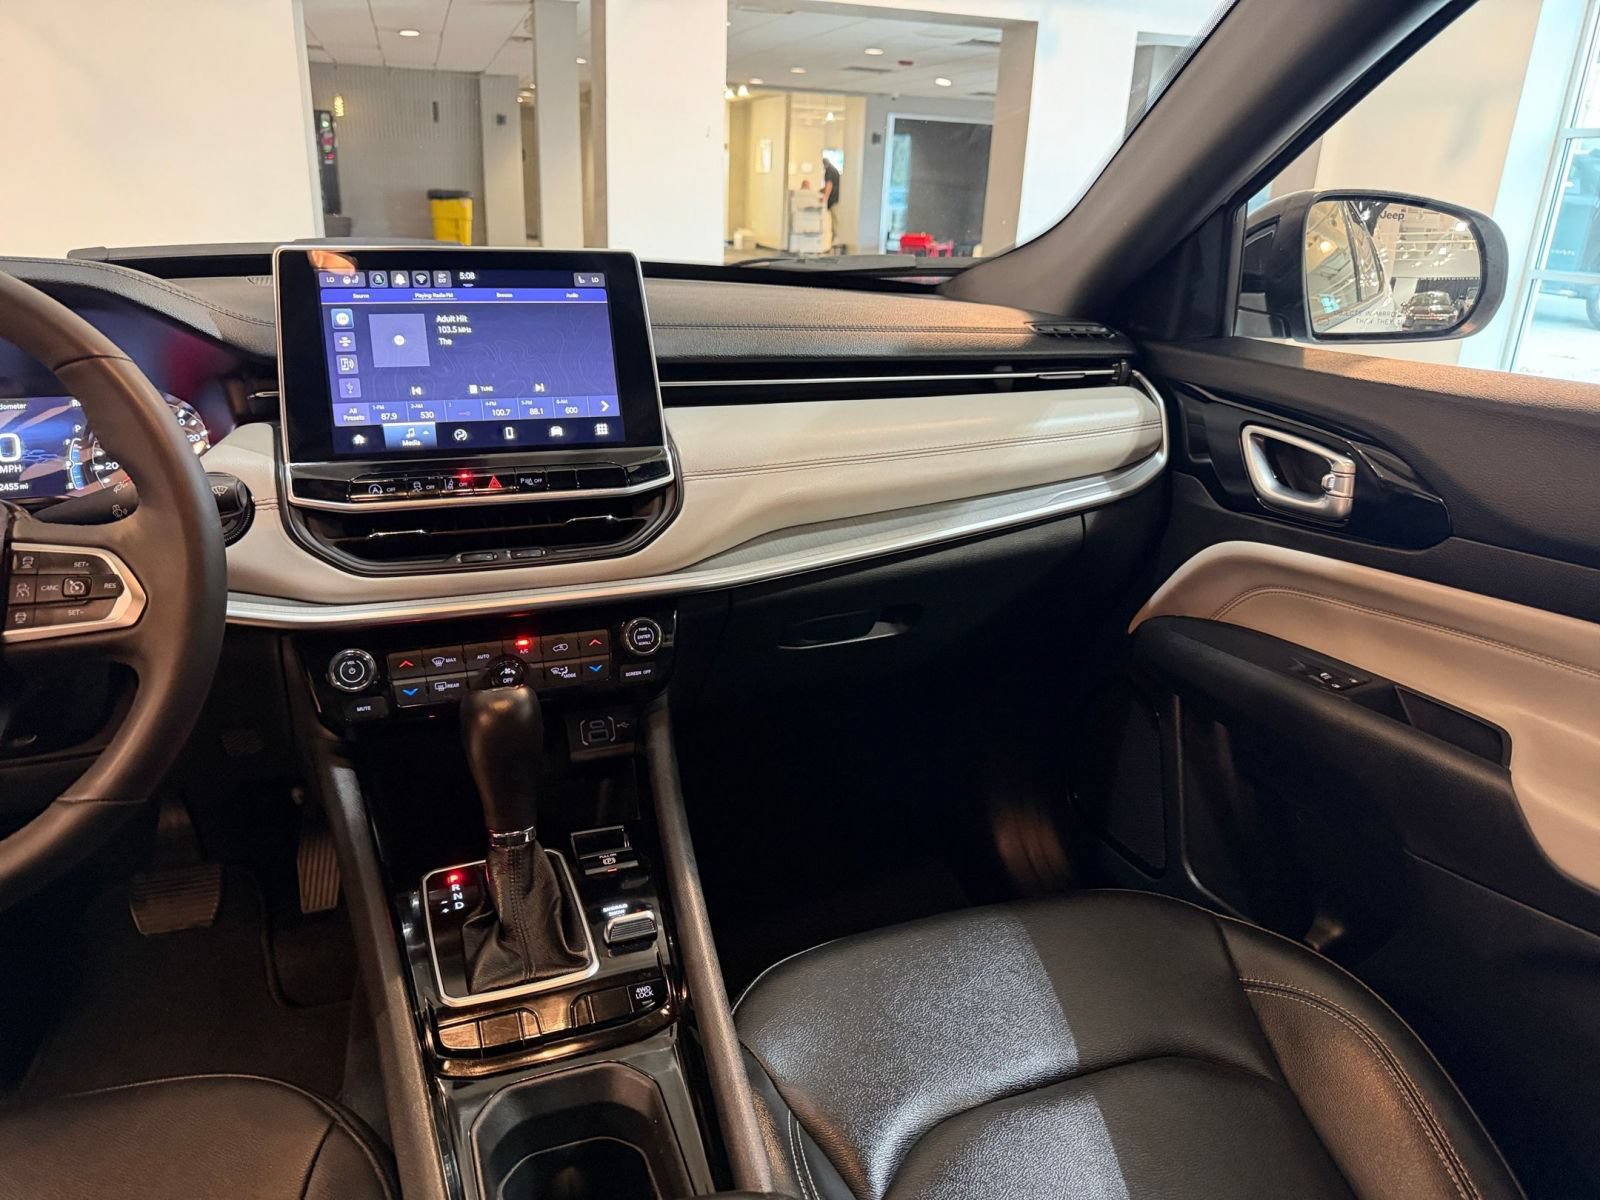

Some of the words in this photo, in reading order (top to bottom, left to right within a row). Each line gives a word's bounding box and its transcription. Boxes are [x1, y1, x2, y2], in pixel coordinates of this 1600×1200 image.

[1380, 210, 1405, 221] Jeep
[459, 271, 476, 281] 5:08
[436, 314, 456, 323] Adult
[456, 314, 468, 323] Hit
[438, 325, 457, 334] 103.5
[438, 337, 453, 346] The
[492, 408, 510, 416] 100.7
[529, 407, 544, 415] 88.1
[565, 406, 578, 414] 600
[380, 412, 397, 420] 87.9
[420, 411, 434, 419] 530
[0, 464, 22, 474] MPH
[450, 874, 459, 883] P
[451, 883, 461, 892] R
[452, 891, 463, 901] N
[454, 901, 465, 910] D
[635, 985, 651, 993] 4WD
[635, 990, 654, 999] LOCK
